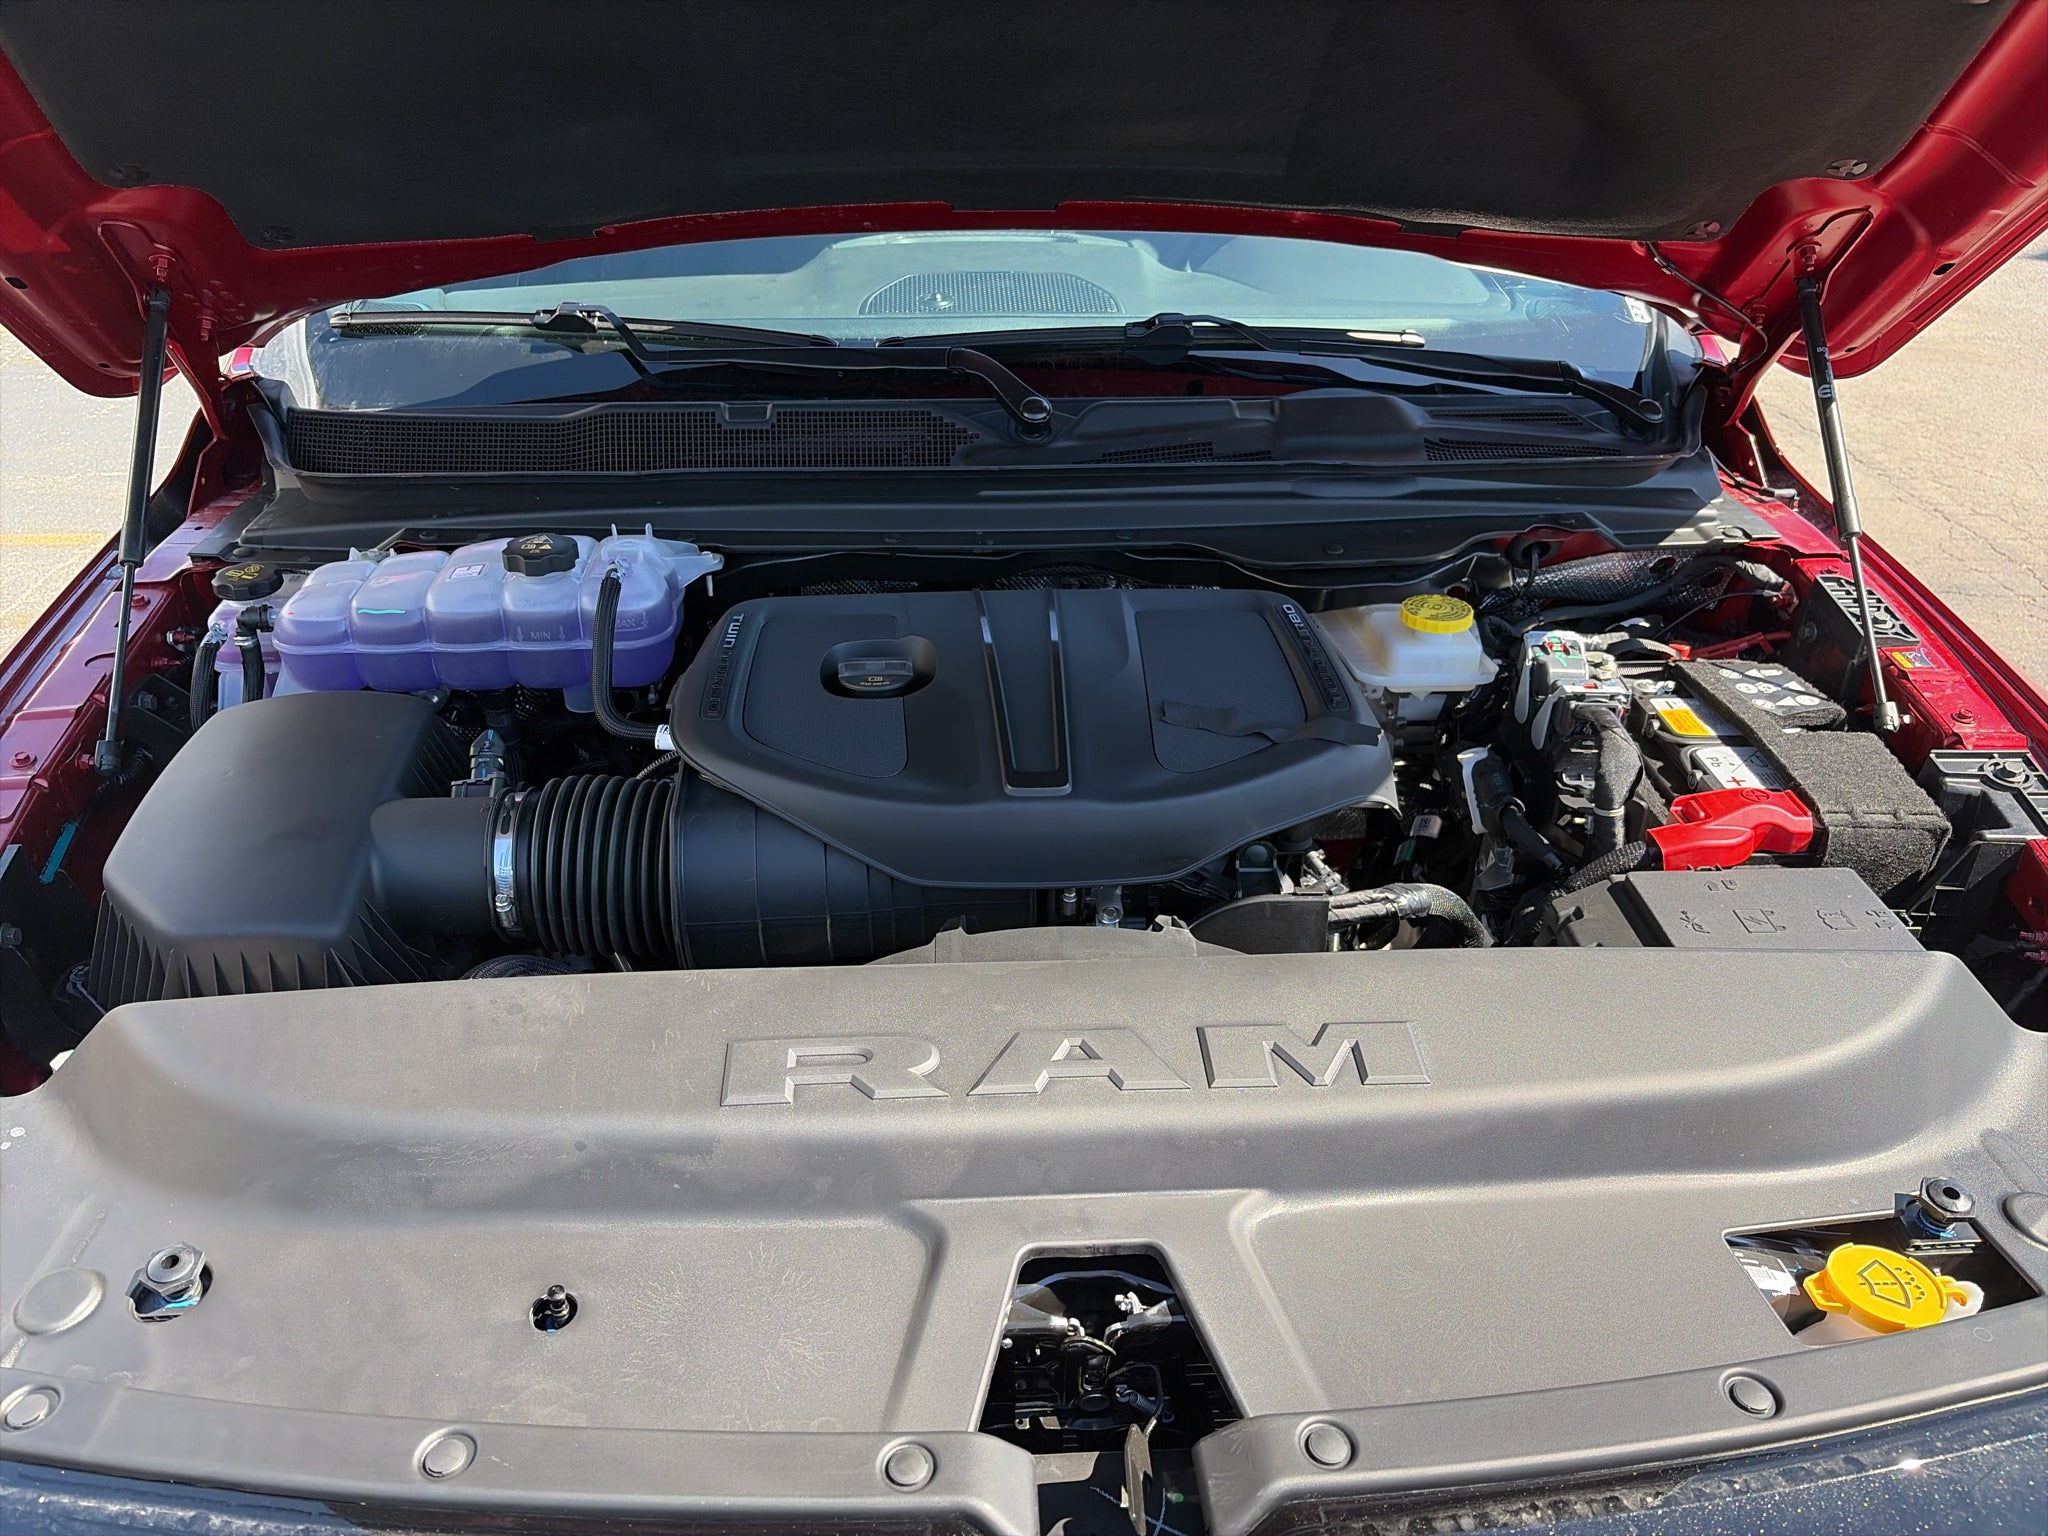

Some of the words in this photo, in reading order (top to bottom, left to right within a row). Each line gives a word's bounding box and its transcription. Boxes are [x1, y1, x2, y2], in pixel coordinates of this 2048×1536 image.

[530, 631, 551, 640] MIN
[723, 613, 745, 648] TWIN
[720, 1021, 1431, 1106] RAM
